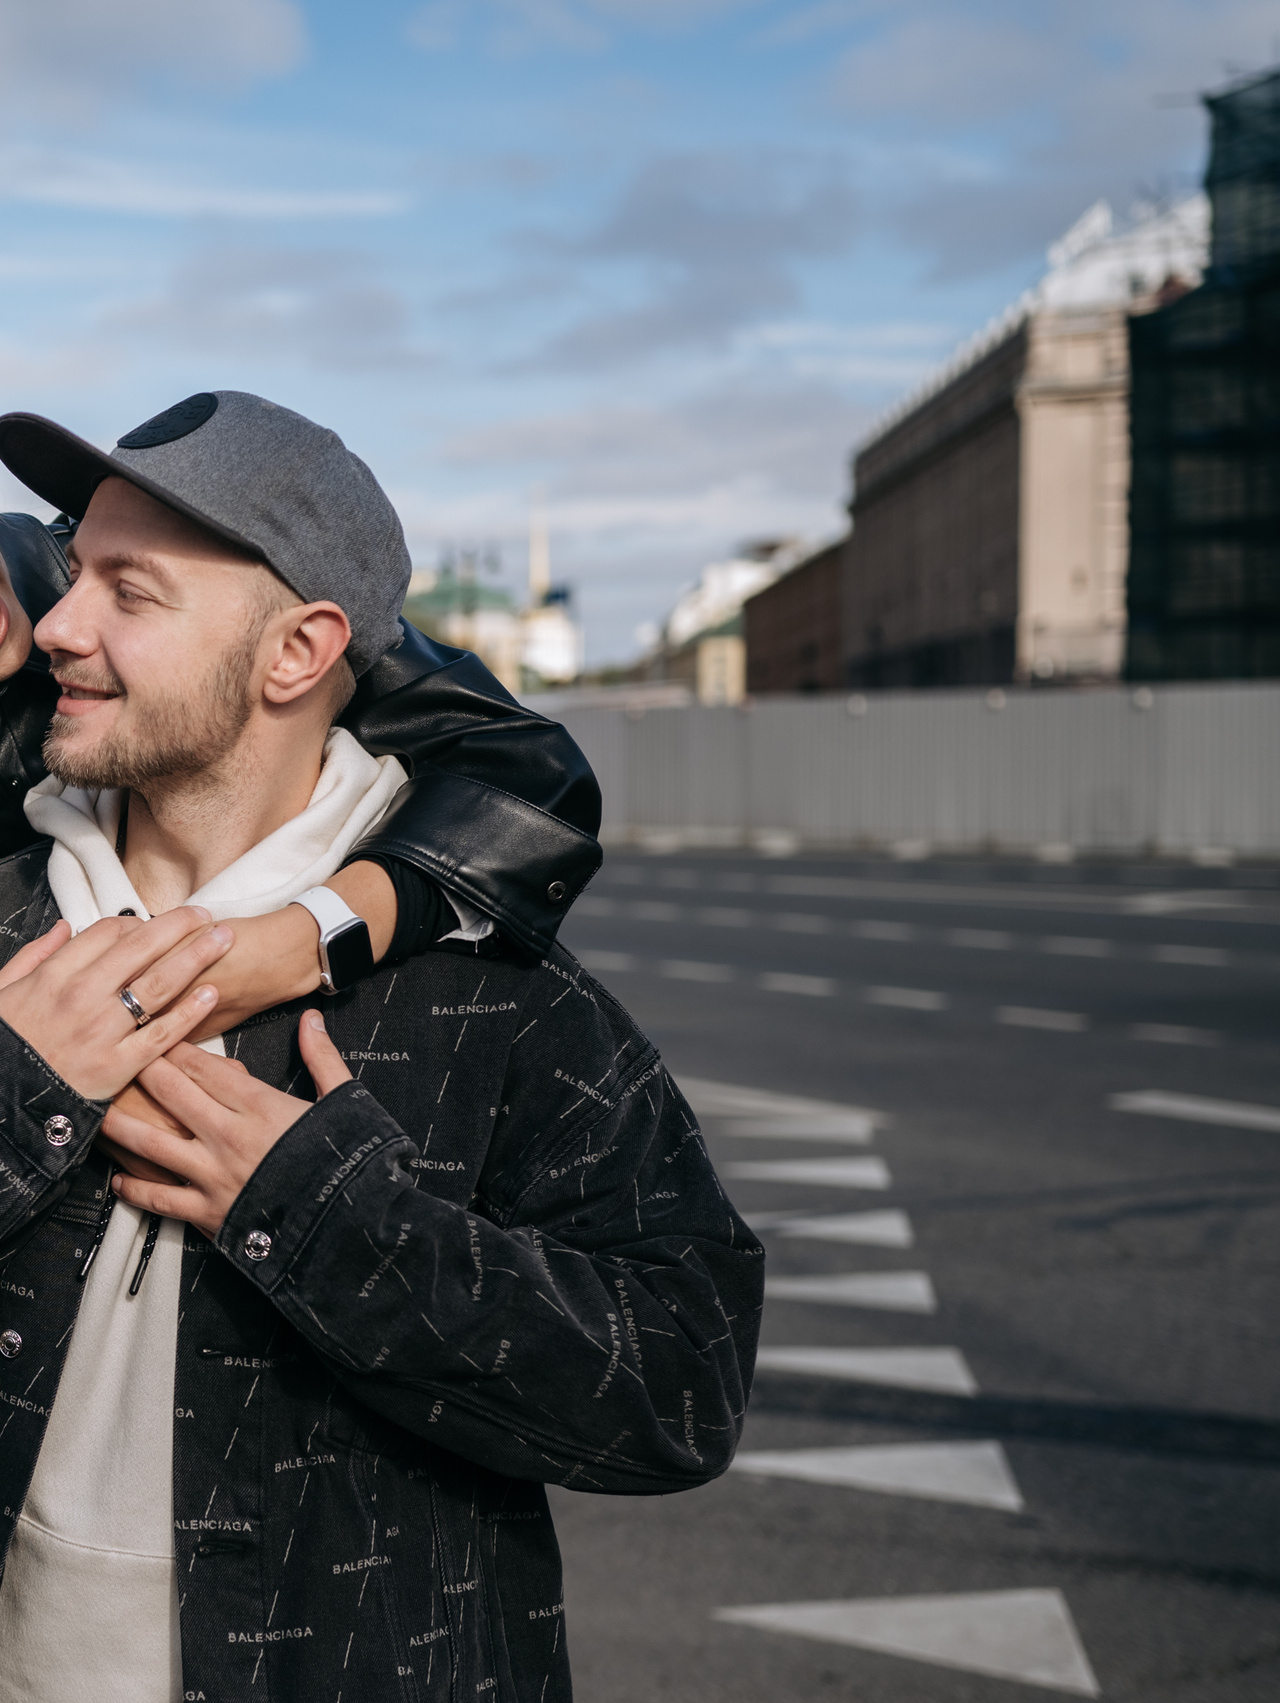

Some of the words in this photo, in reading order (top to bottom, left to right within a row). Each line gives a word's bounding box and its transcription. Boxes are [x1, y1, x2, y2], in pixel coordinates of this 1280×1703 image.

[431, 1001, 517, 1016] BALENCIAGA
[315, 1136, 383, 1203] BALENCIAGA
[592, 1313, 621, 1398] BALENCIAGA
[228, 1626, 313, 1643] BALENCIAGA
